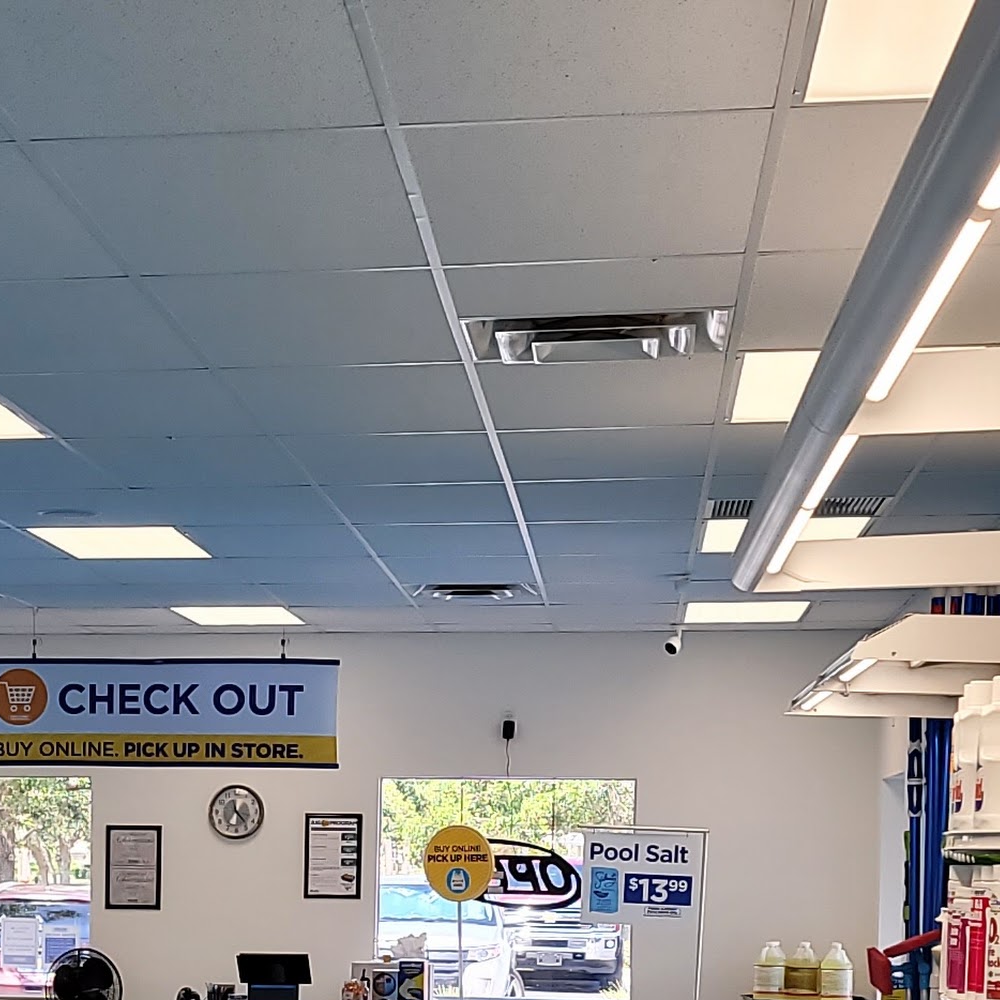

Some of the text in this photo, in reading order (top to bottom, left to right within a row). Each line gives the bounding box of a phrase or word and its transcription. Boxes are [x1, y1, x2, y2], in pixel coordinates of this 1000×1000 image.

[58, 683, 304, 716] CHECK OUT
[39, 742, 119, 757] ONLINE.
[124, 743, 172, 758] PICK
[173, 743, 200, 759] UP
[204, 743, 221, 759] IN
[230, 743, 304, 759] STORE.
[427, 853, 489, 863] PICK UP HERE
[589, 842, 689, 864] Pool Salt
